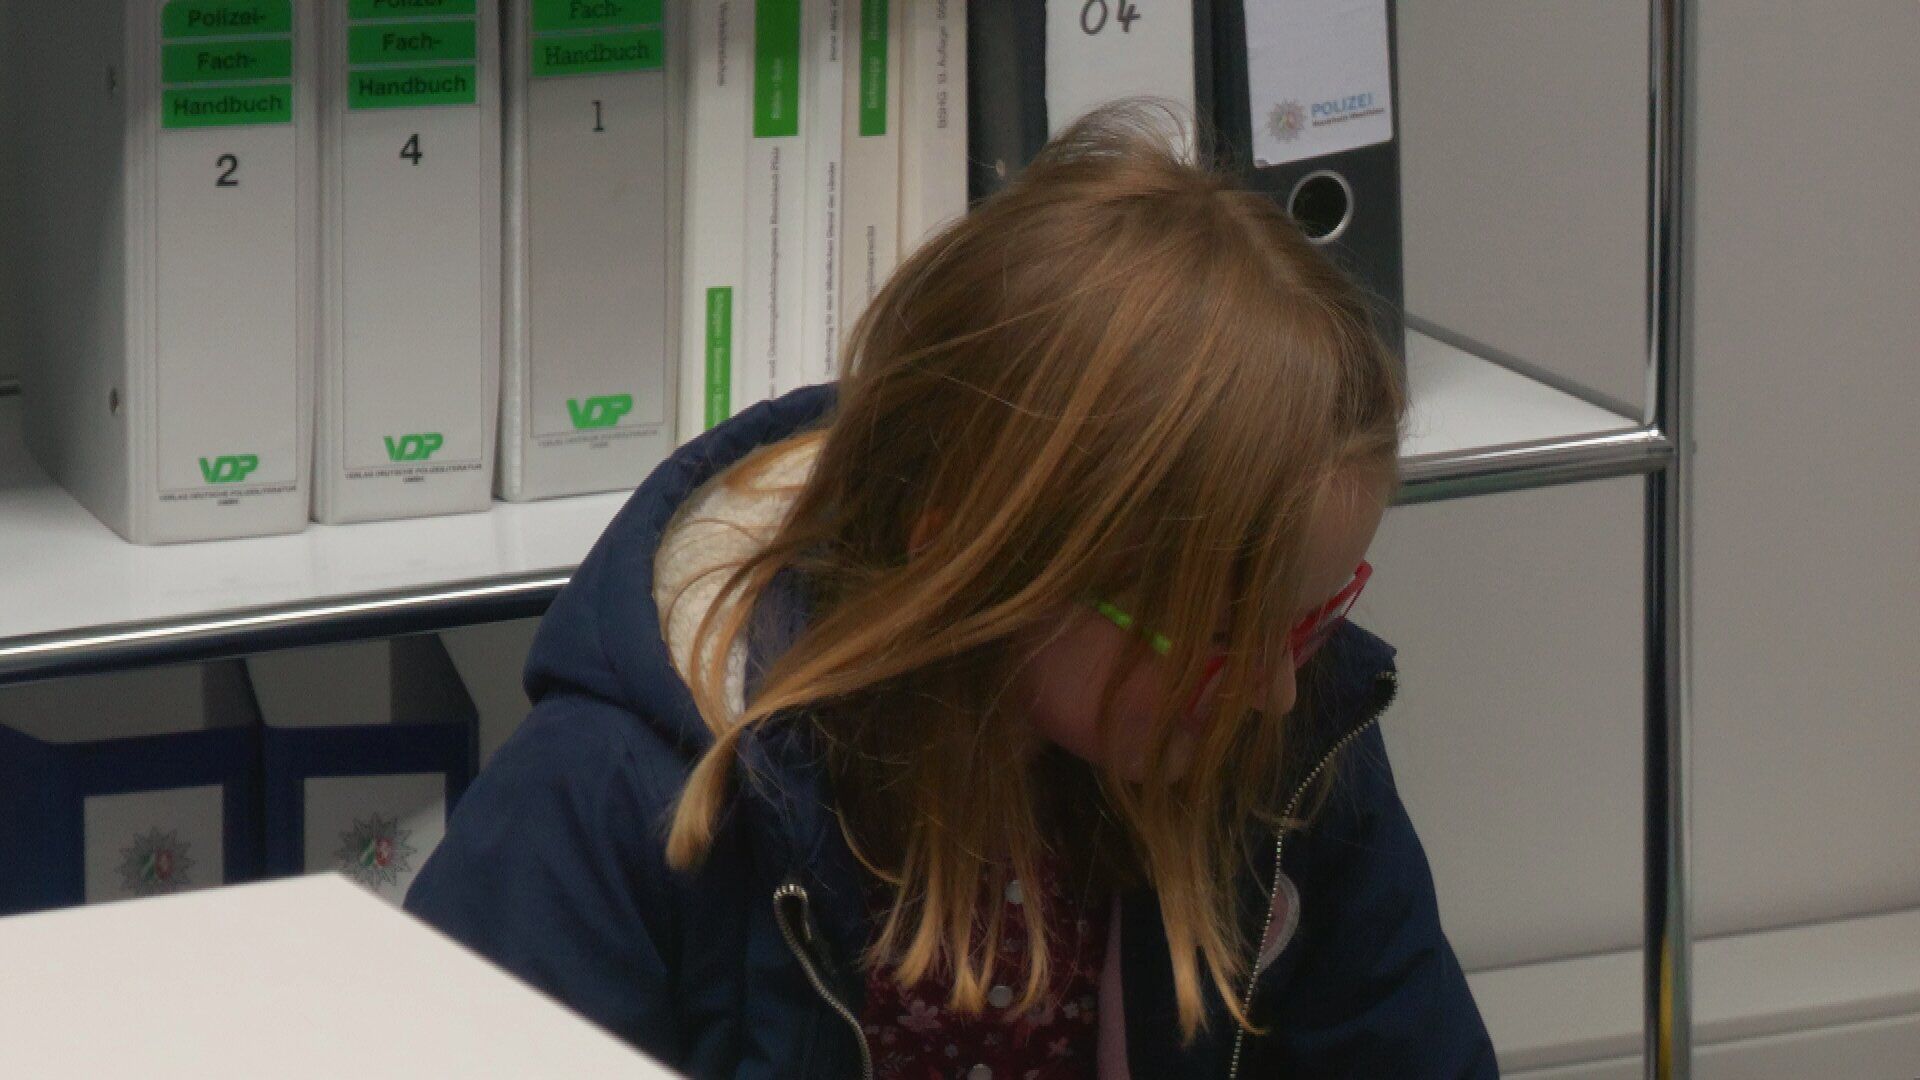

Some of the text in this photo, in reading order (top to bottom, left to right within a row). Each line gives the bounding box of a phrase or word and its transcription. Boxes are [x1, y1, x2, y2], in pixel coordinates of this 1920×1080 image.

[187, 8, 266, 27] Polizei-
[382, 32, 440, 50] Fach-
[544, 41, 649, 65] Handbuch
[198, 51, 257, 70] Fach-
[359, 75, 466, 96] Handbuch
[174, 94, 282, 116] Handbuch
[591, 100, 605, 133] 1
[1311, 92, 1376, 117] POLIZEI
[400, 133, 423, 166] 4
[216, 154, 239, 187] 2
[566, 393, 633, 429] VDP
[383, 432, 444, 462] VDP
[198, 454, 258, 484] VDP
